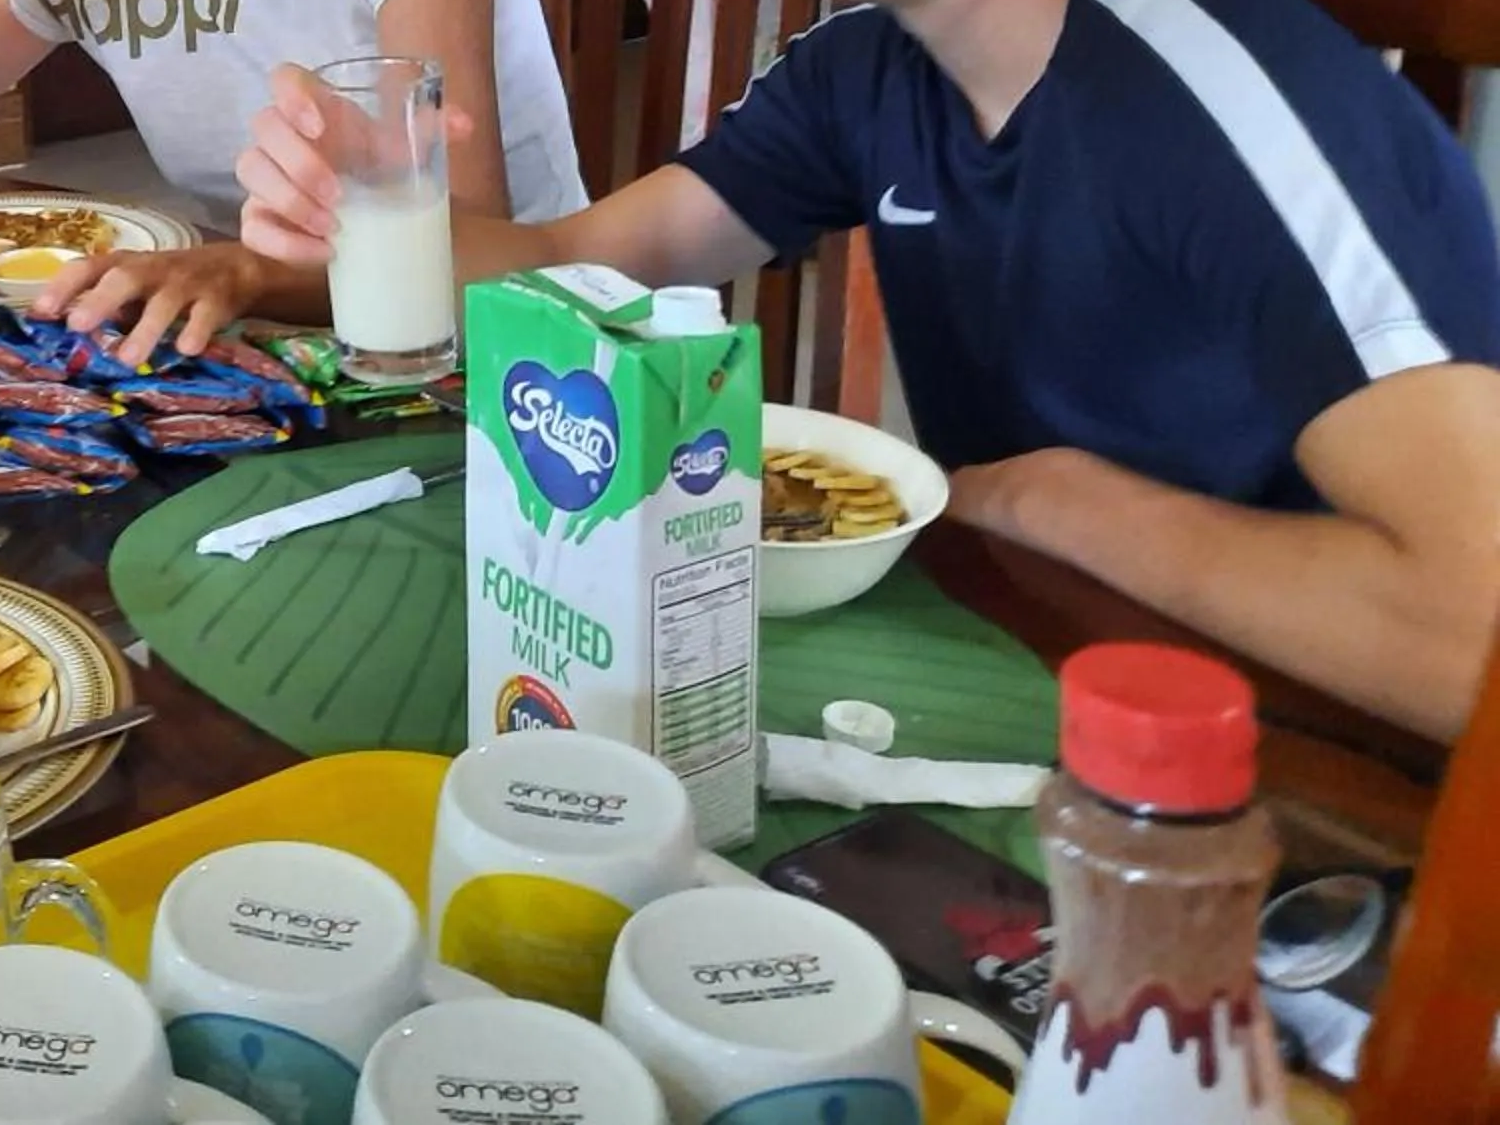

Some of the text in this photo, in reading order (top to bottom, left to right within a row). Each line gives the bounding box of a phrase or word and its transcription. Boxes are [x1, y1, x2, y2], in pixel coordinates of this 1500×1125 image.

[509, 380, 617, 476] Selecta
[664, 500, 744, 546] FORTIFIED
[482, 556, 614, 671] FORTIFIED
[511, 626, 572, 689] MILK
[508, 782, 628, 814] omega
[235, 902, 361, 938] omega
[436, 1080, 580, 1113] omega
